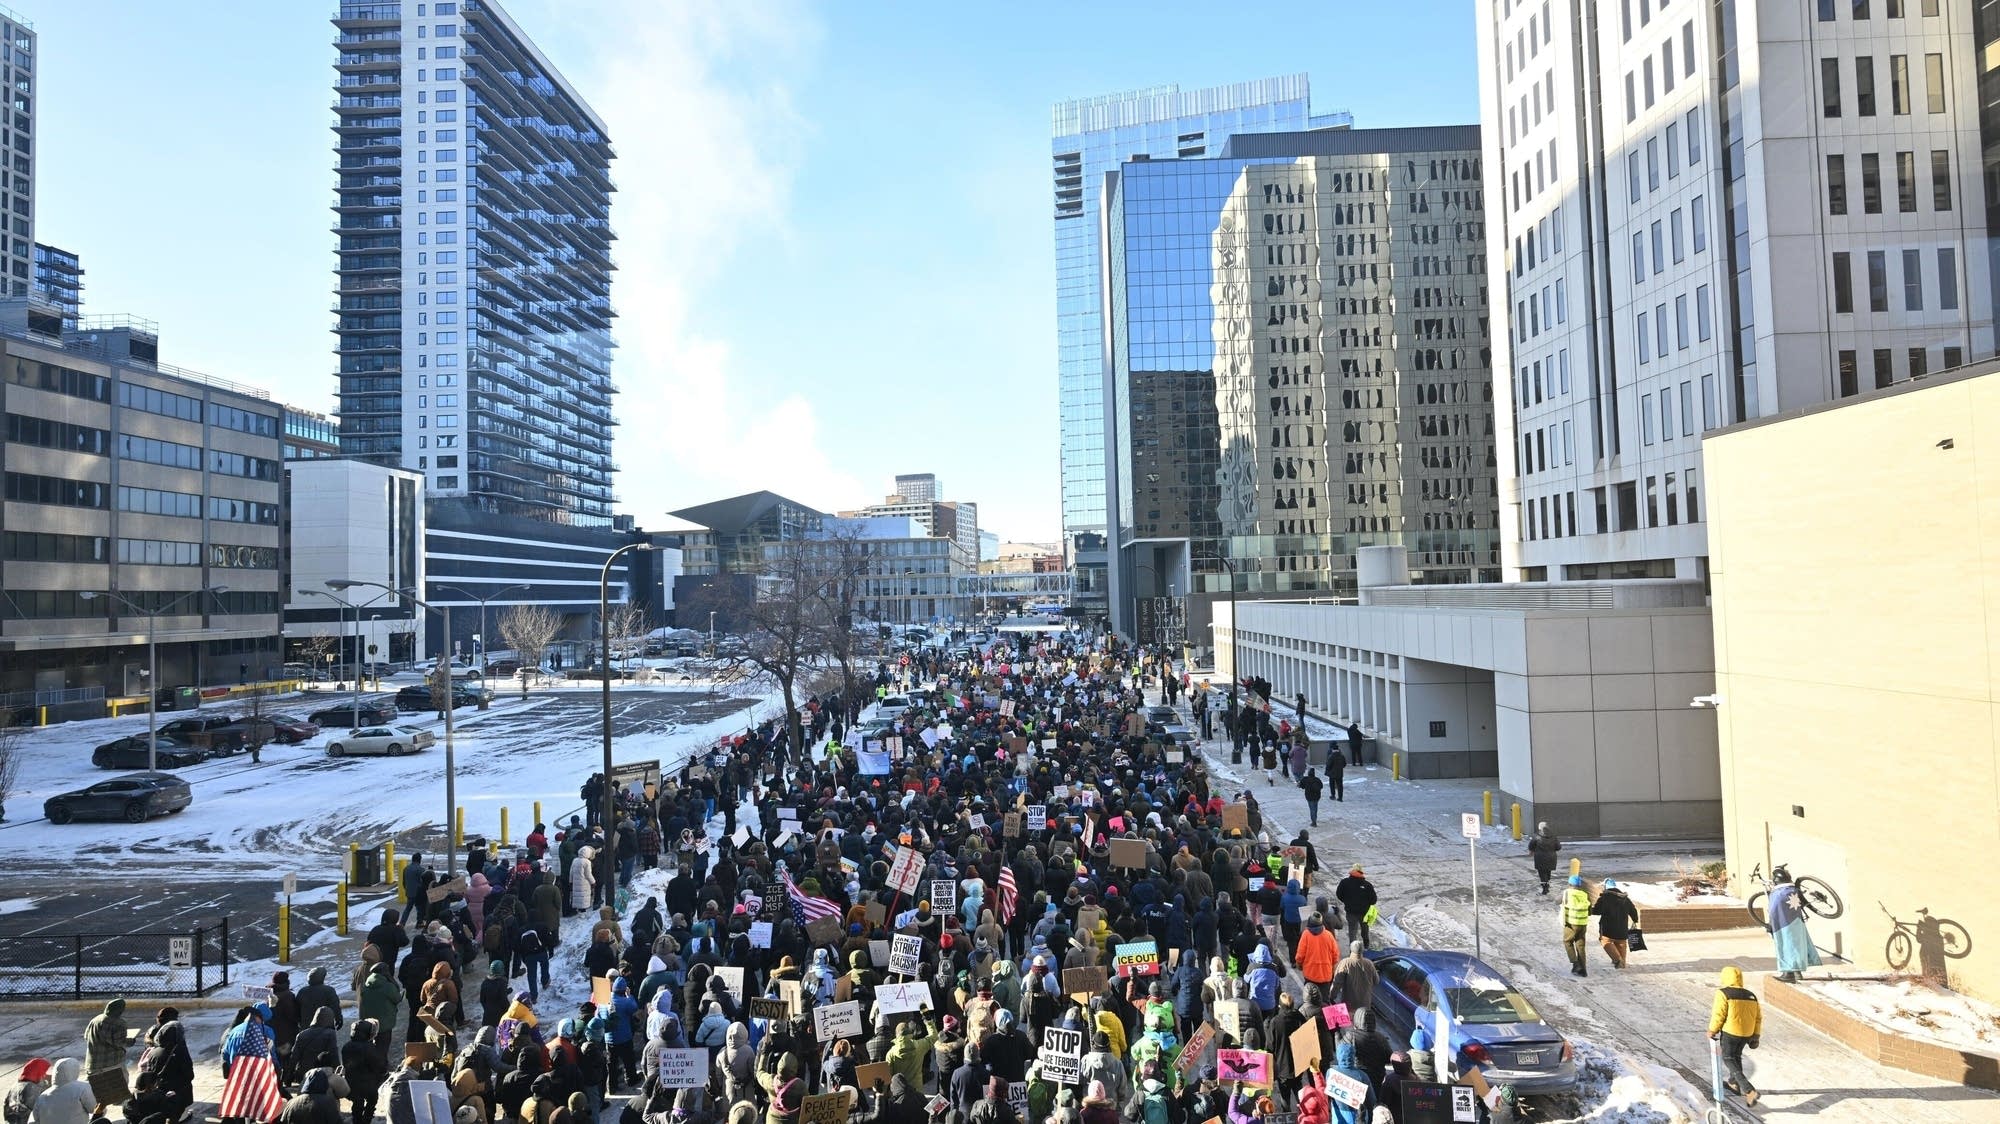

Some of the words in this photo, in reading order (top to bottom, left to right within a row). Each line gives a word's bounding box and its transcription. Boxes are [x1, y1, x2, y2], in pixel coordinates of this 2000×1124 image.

[1029, 807, 1044, 816] STOP
[766, 886, 783, 894] ICE
[894, 941, 919, 956] STRIKE
[891, 956, 917, 971] RACISM
[1118, 956, 1133, 964] ICE
[1135, 954, 1155, 963] OUT
[752, 1002, 787, 1019] RESIST
[823, 1018, 850, 1027] CALLOUS
[823, 1028, 845, 1036] EVIL
[1046, 1030, 1079, 1054] STOP
[1045, 1054, 1053, 1065] ICE
[1055, 1055, 1078, 1068] TERROR
[1044, 1065, 1078, 1075] NOW!
[1329, 1084, 1348, 1100] ICE
[805, 1095, 845, 1115] RENEE
